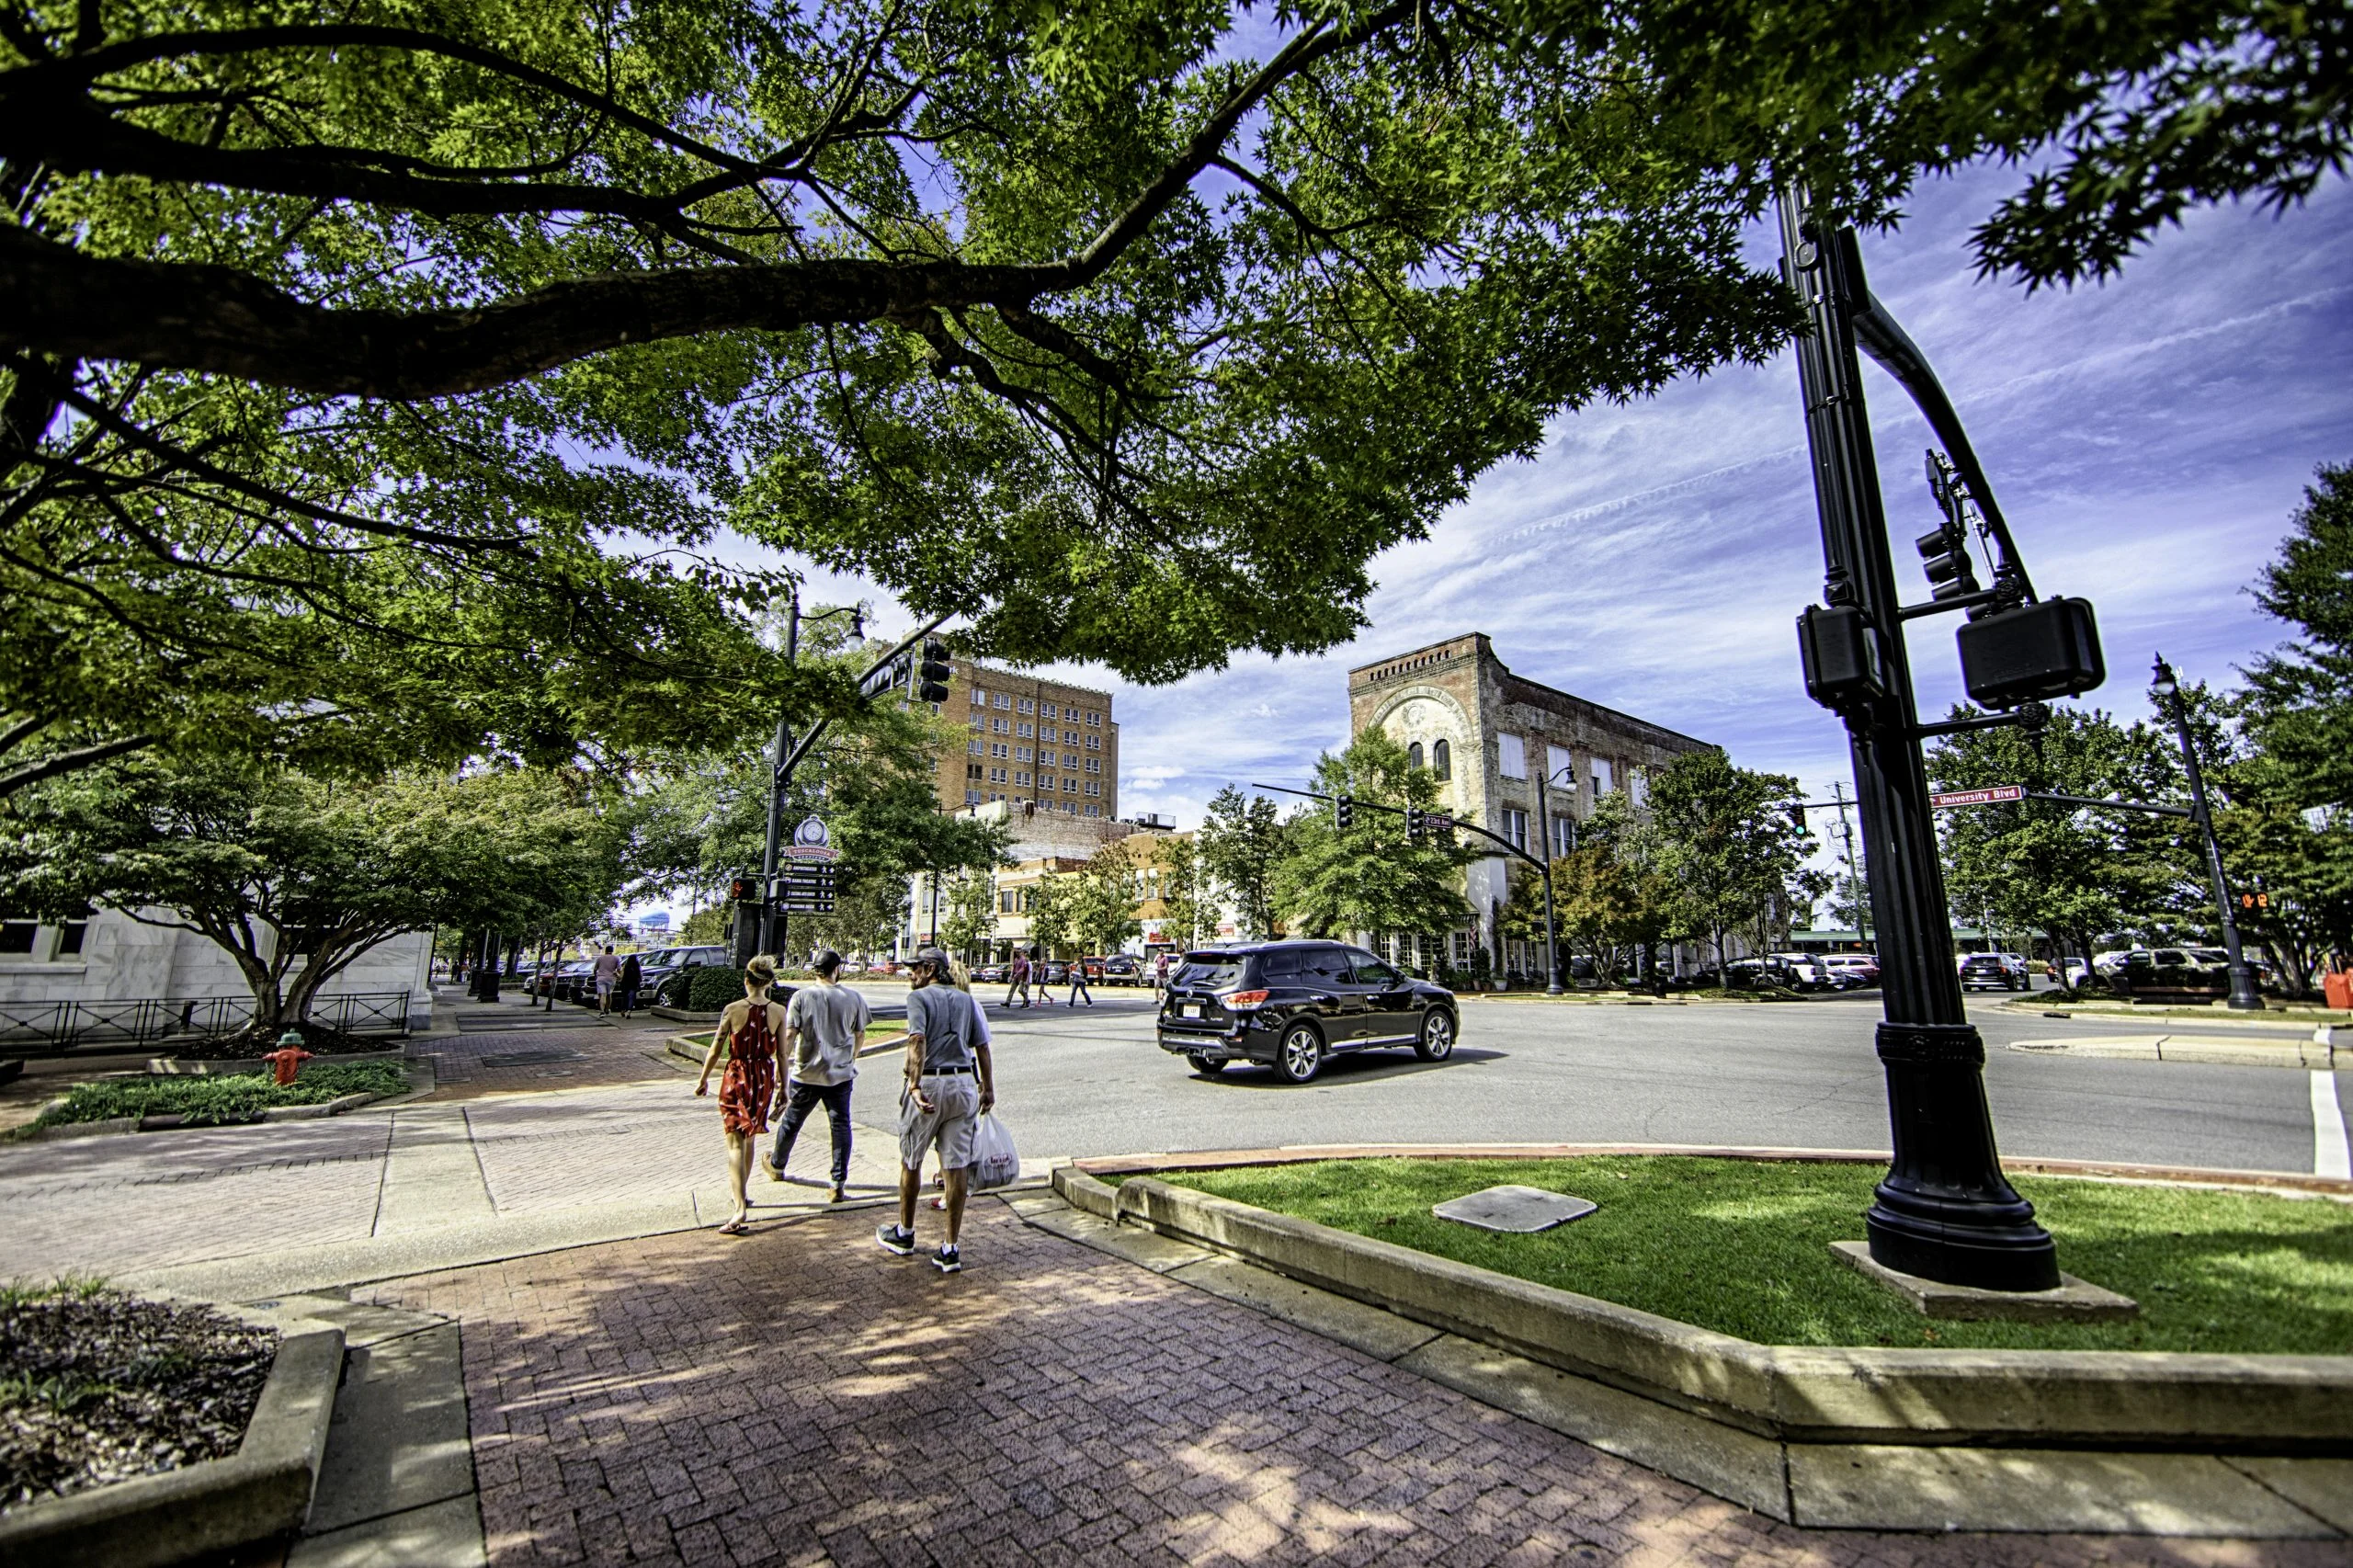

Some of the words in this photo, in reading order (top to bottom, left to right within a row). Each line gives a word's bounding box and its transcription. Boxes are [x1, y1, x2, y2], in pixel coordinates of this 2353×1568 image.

[1939, 791, 1989, 804] University
[1993, 789, 2016, 799] Blvd
[1430, 817, 1441, 825] 23rd
[793, 848, 831, 857] TUSCALOOSA
